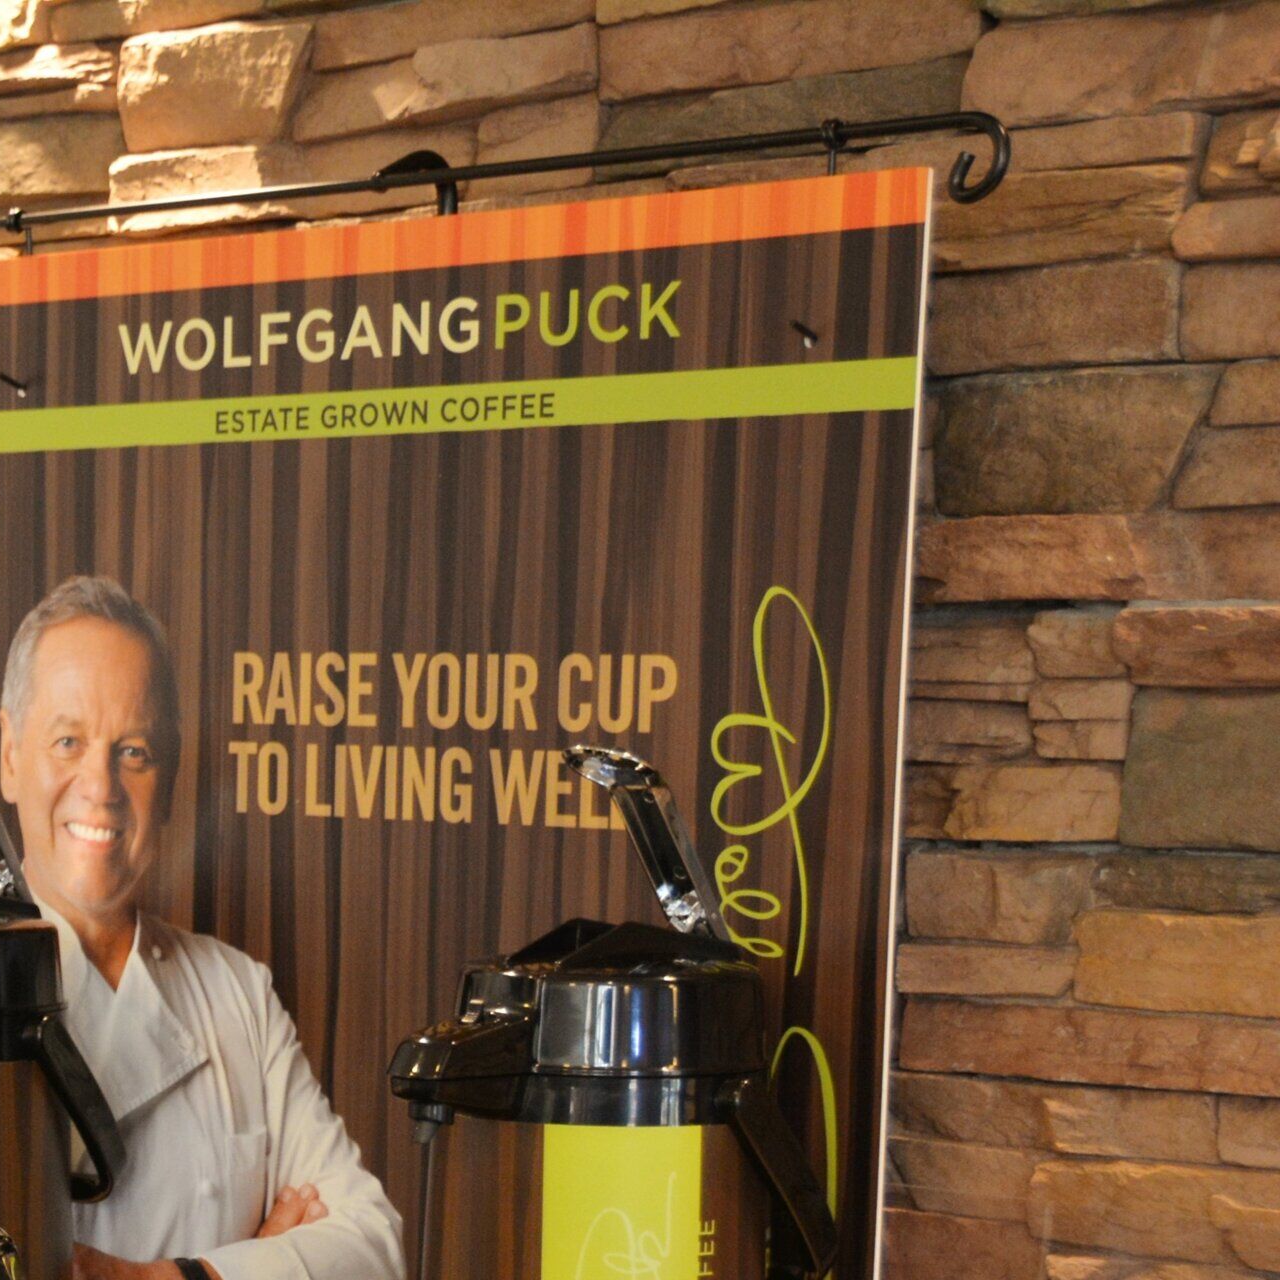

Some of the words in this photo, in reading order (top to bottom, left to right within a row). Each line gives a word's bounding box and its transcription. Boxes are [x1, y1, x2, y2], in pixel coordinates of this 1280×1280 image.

[214, 408, 310, 435] ESTATE
[320, 401, 430, 430] GROWN
[440, 393, 555, 423] COFFEE
[232, 651, 376, 729] RAISE
[392, 652, 539, 732] YOUR
[557, 653, 679, 735] CUP
[230, 741, 289, 813] TO
[306, 744, 473, 824] LIVING
